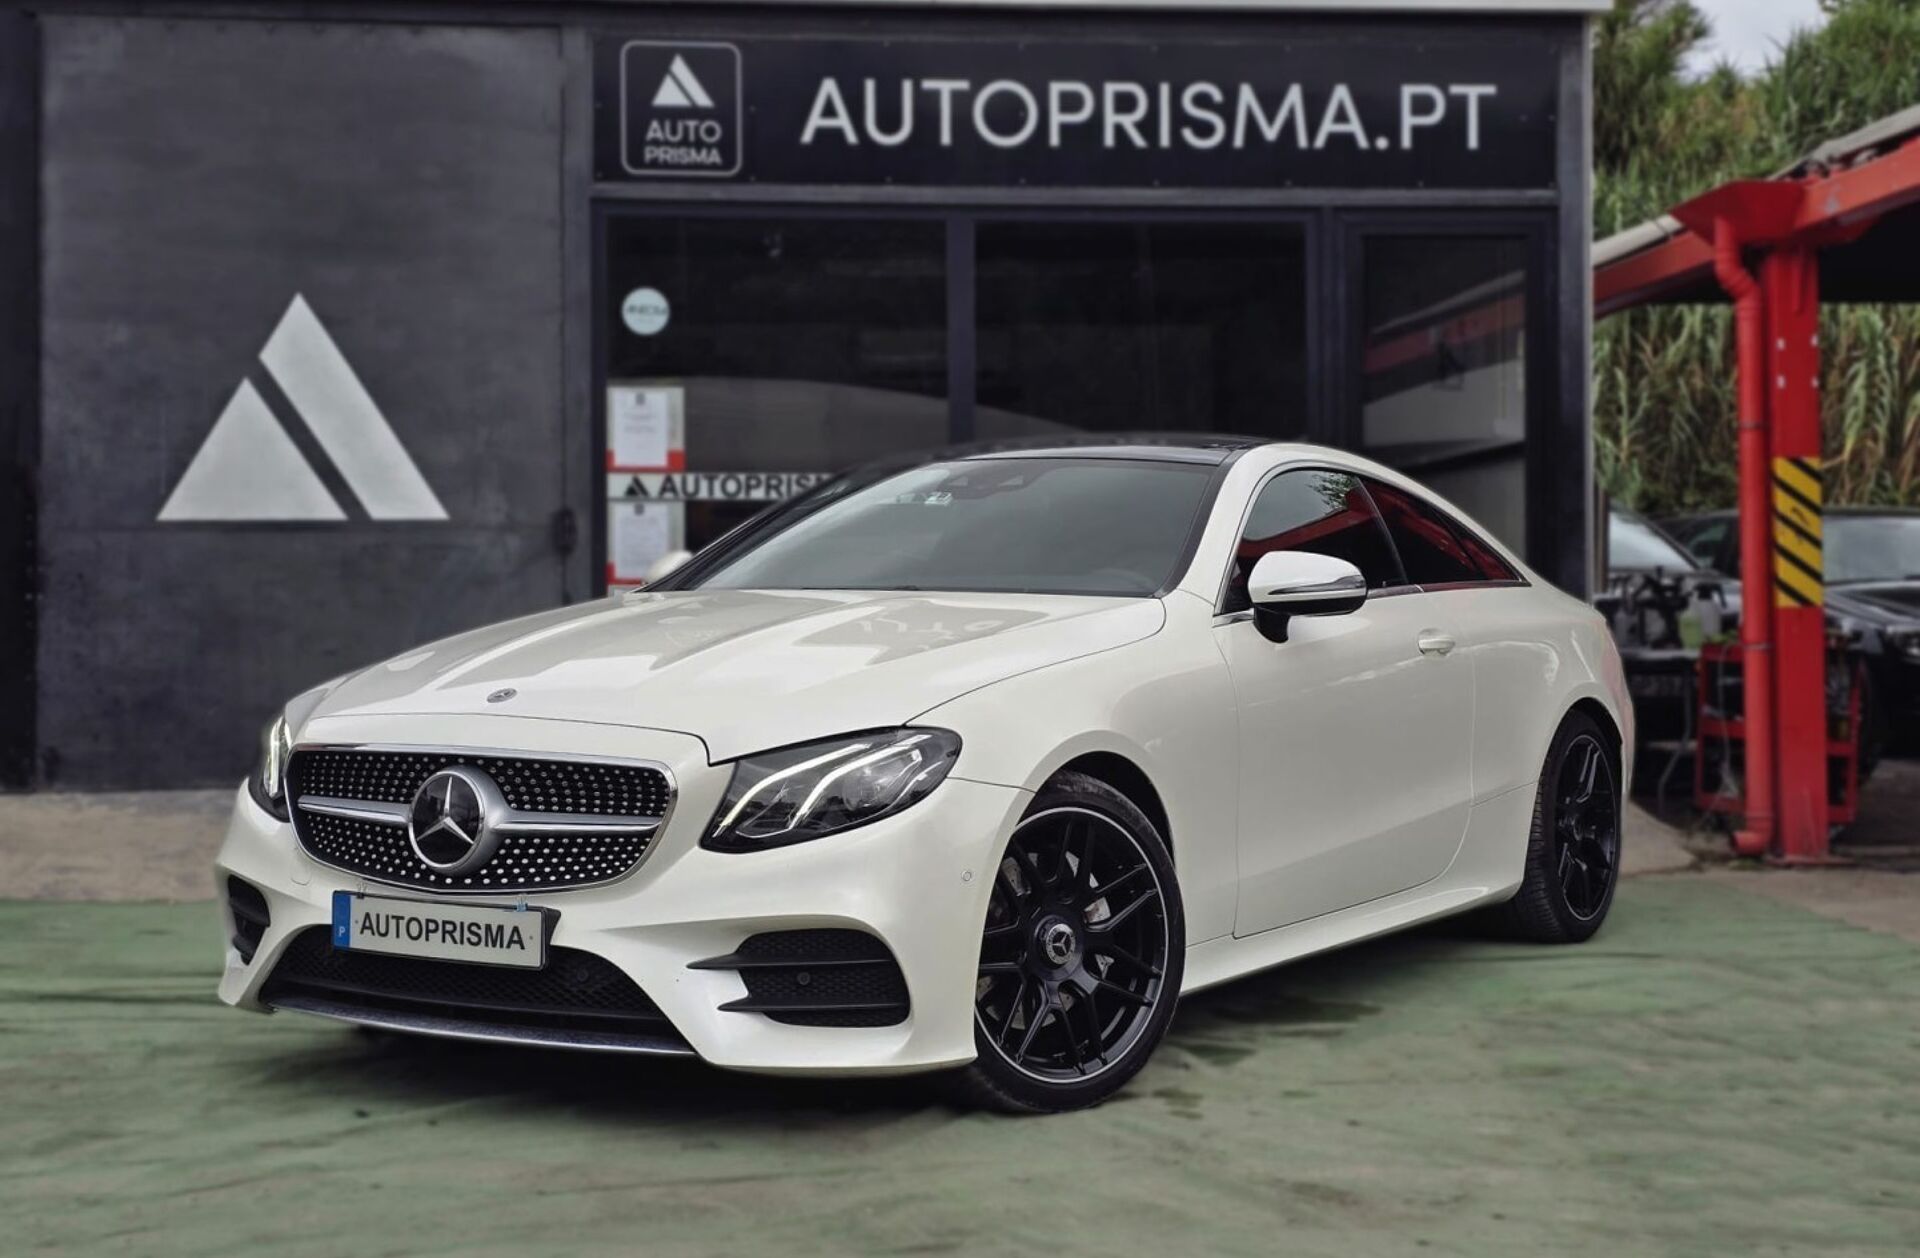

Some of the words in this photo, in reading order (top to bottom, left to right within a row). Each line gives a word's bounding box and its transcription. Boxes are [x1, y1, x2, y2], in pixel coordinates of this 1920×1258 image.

[801, 77, 1498, 152] AUTOPRISMA.PT
[645, 119, 722, 142] AUTO
[644, 146, 722, 165] PRISMA
[658, 473, 832, 498] AUTOPRIS
[338, 925, 346, 937] P
[360, 911, 525, 950] AUTOPRISMA
